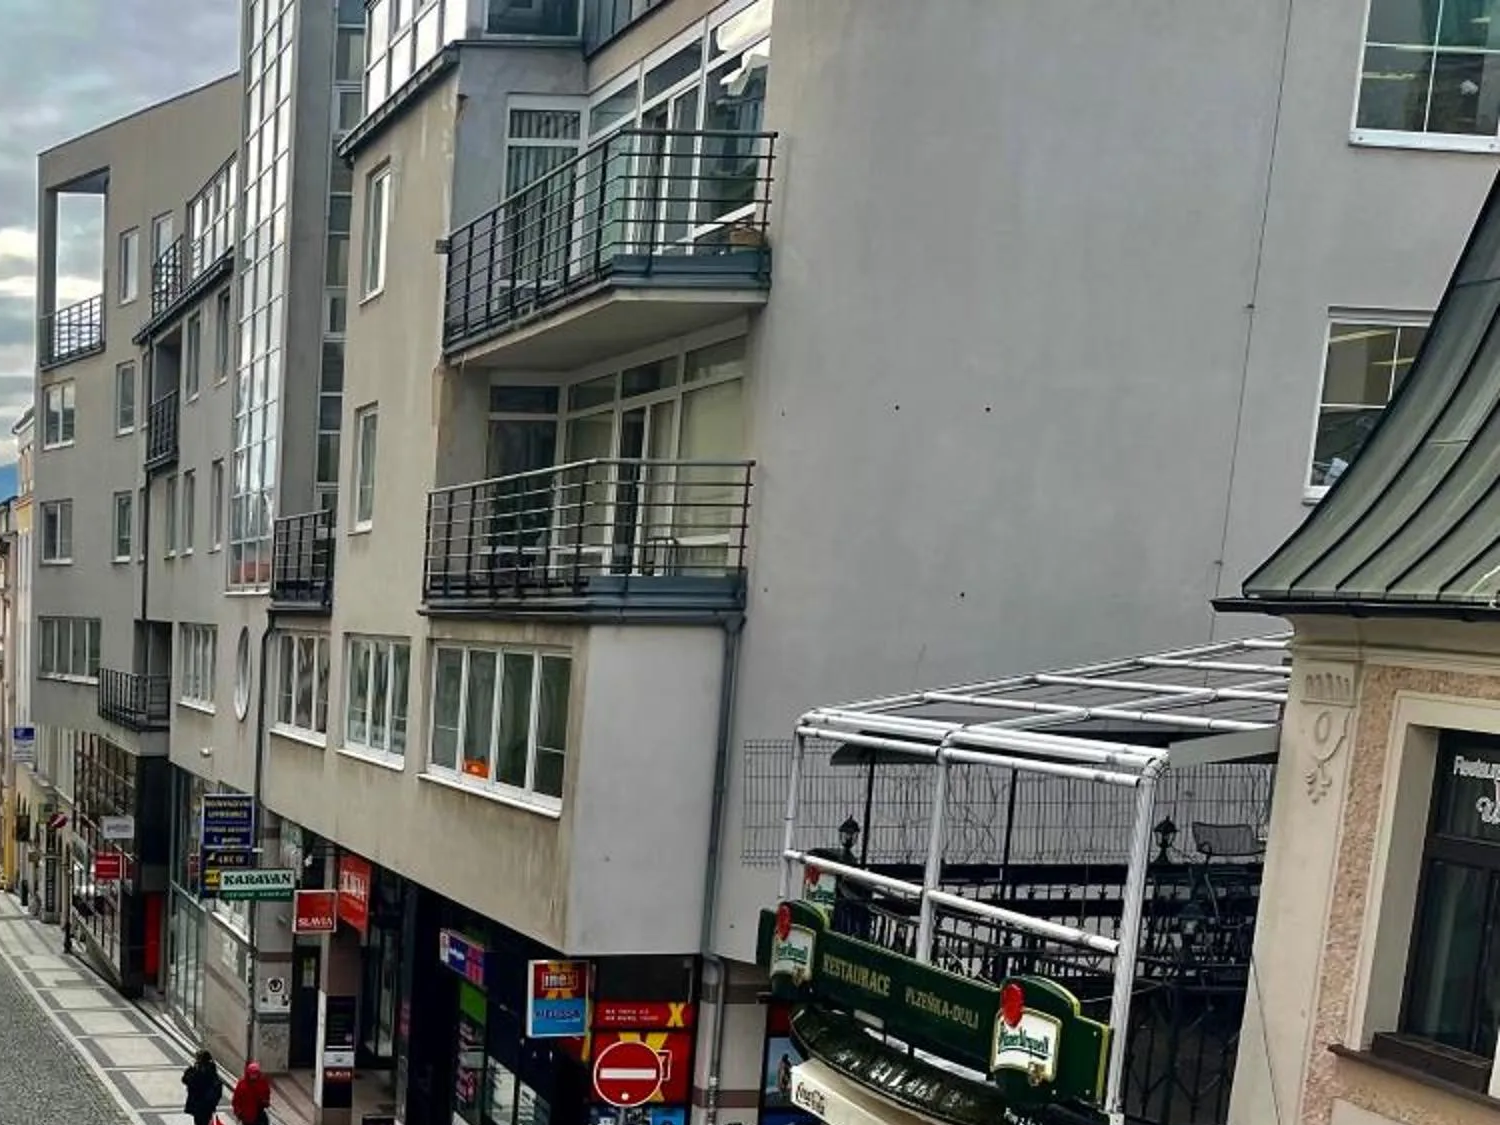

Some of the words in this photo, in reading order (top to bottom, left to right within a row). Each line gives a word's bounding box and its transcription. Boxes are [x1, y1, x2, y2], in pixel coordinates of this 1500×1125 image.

[224, 873, 292, 885] KARAVAN
[298, 916, 333, 929] SLAVIA
[822, 952, 891, 997] RESTAURACE
